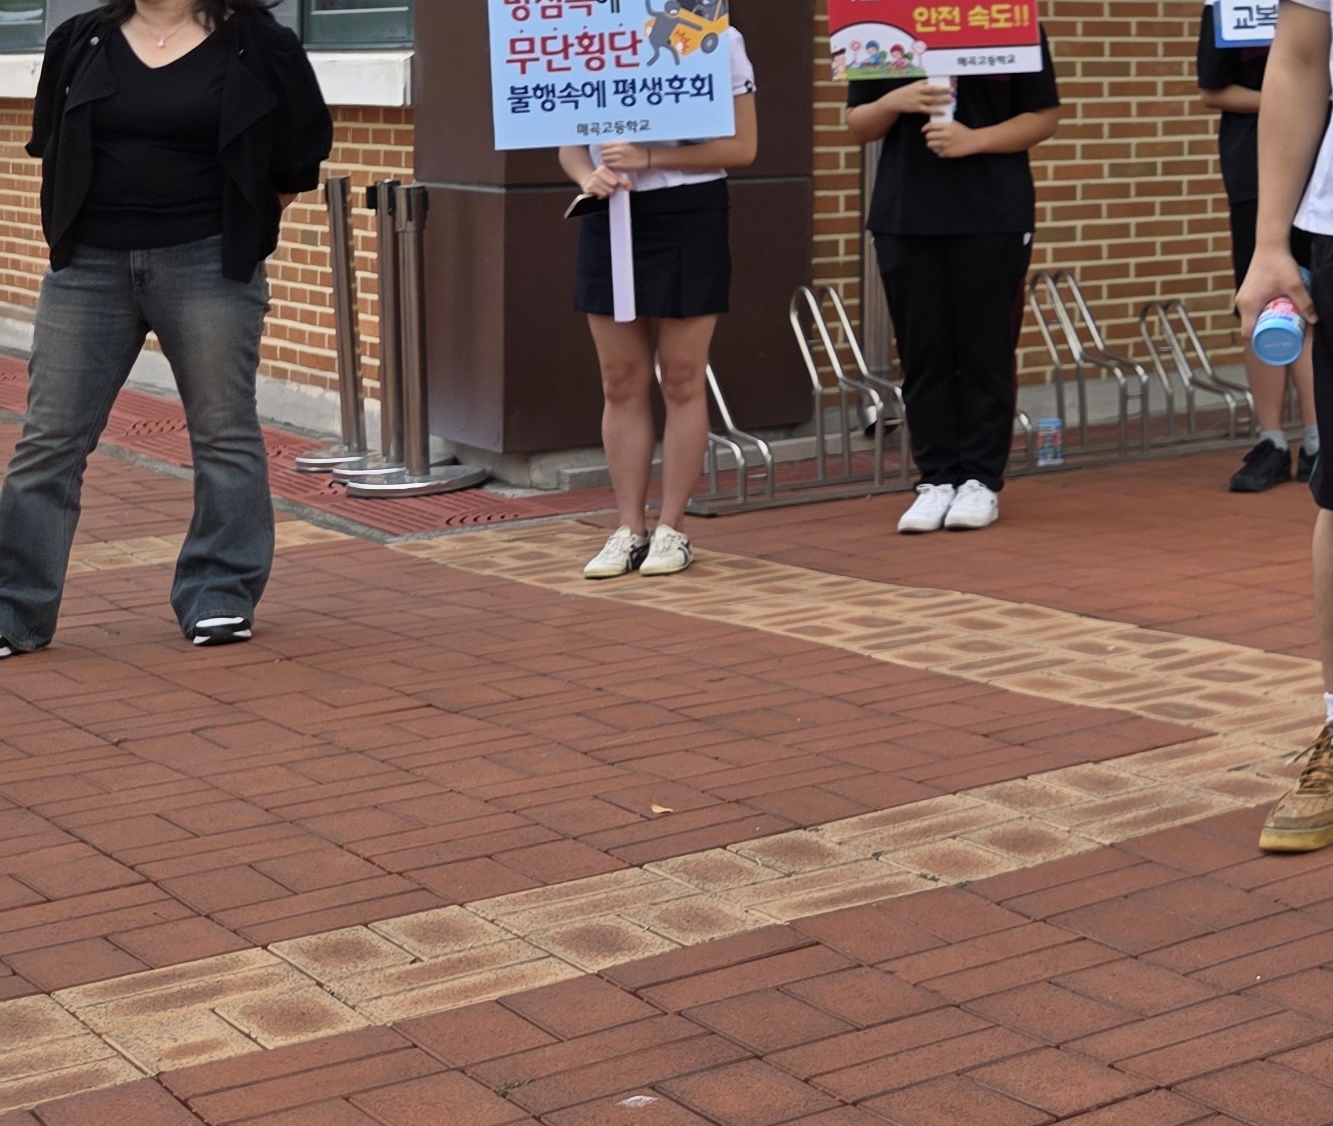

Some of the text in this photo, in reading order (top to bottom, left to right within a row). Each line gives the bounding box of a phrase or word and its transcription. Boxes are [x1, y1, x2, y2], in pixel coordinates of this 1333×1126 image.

[912, 4, 1030, 33] 안전 속도!!
[506, 29, 643, 75] 무단횡단
[507, 73, 715, 114] 불행속에 평생후회
[576, 119, 652, 137] 매곡고등학교
